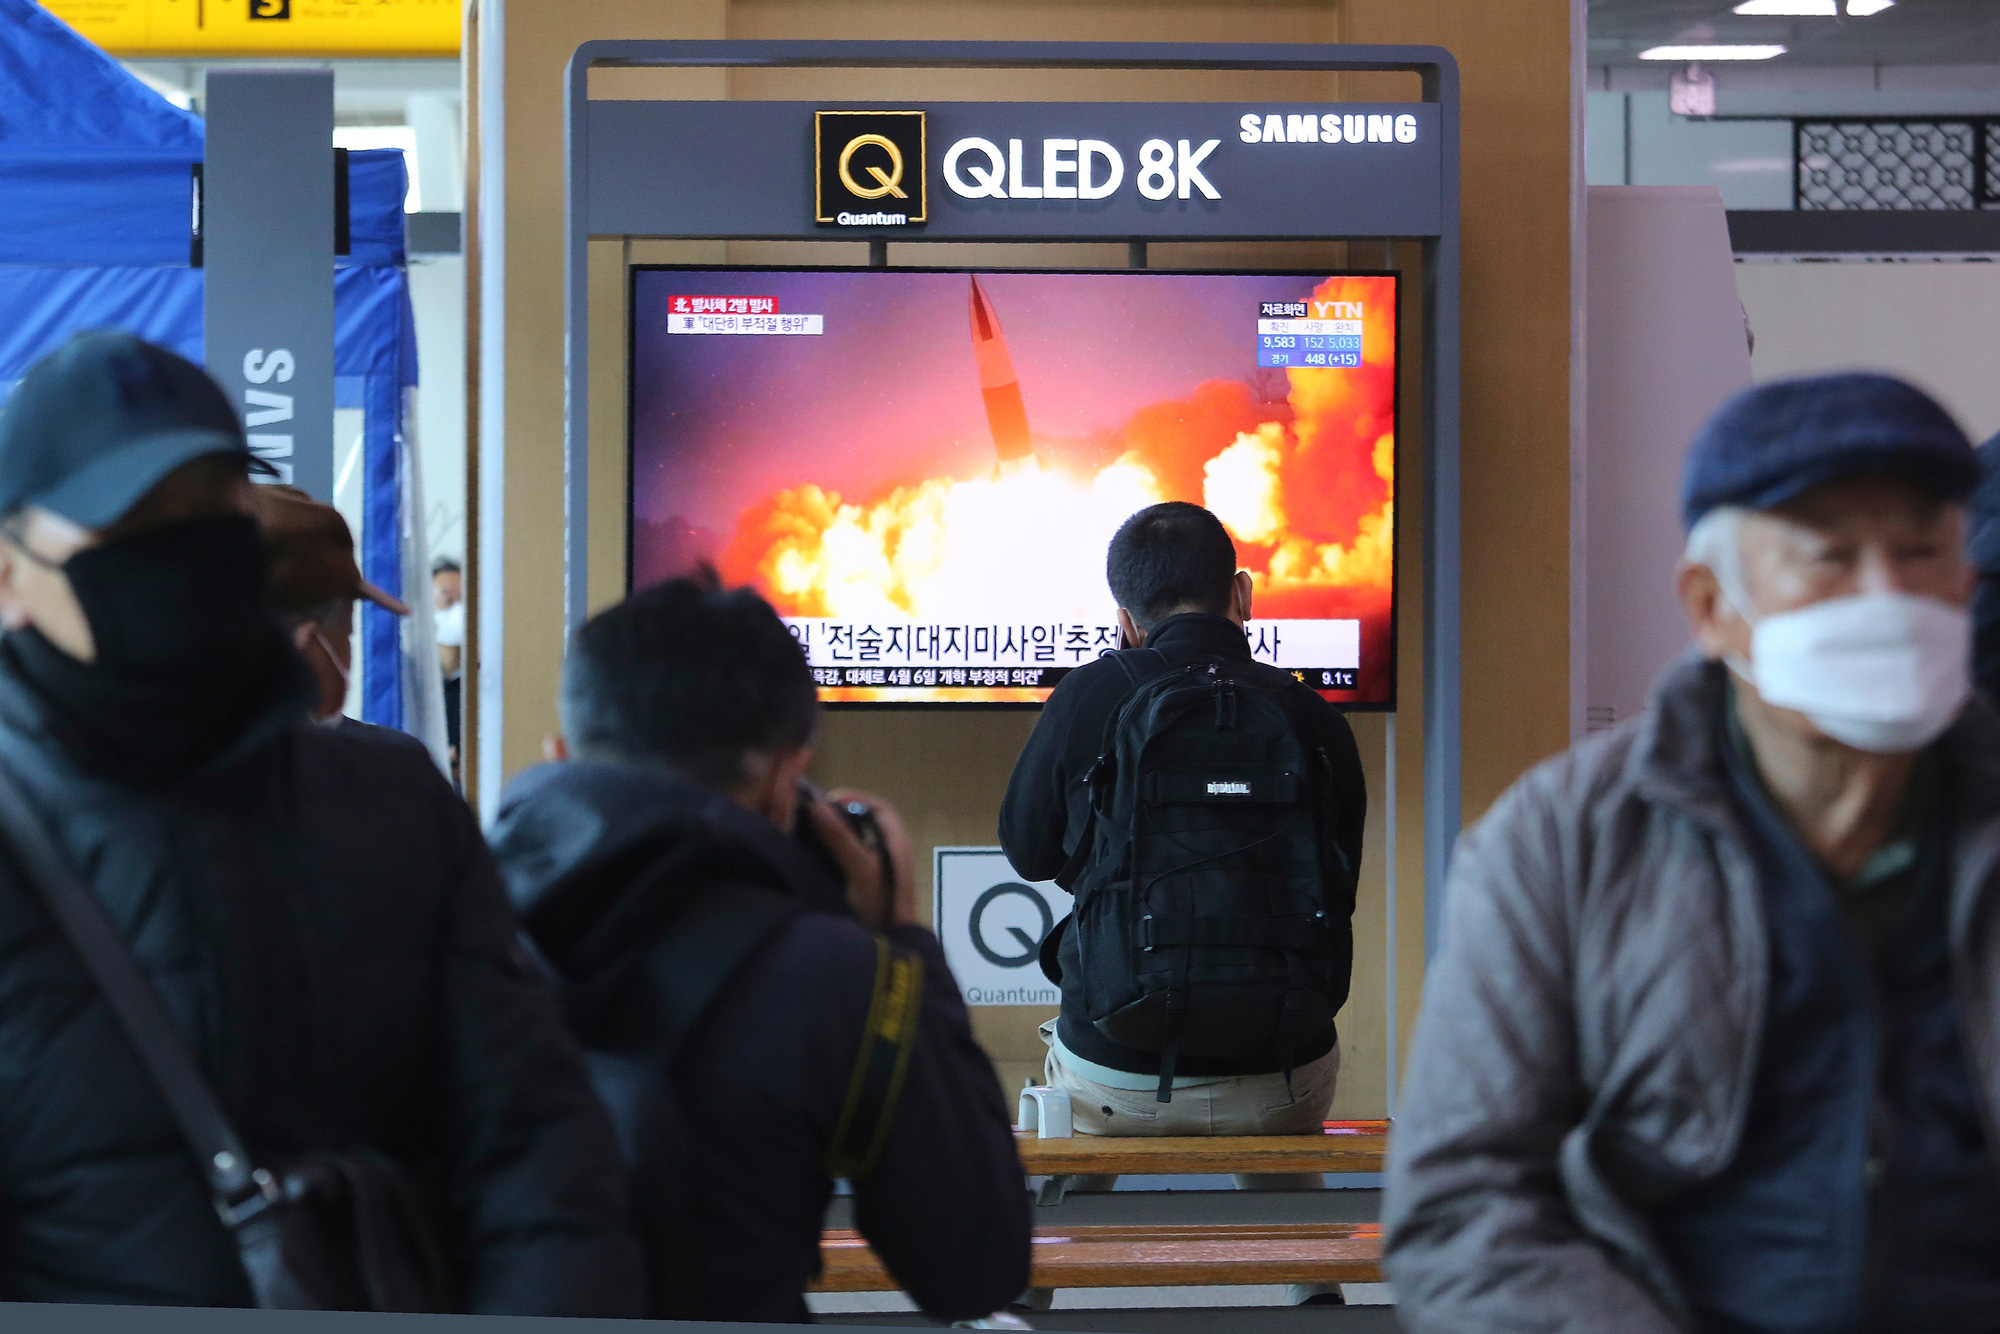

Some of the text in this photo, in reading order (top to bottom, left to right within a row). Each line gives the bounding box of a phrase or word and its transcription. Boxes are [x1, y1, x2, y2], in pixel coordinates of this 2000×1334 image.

[1239, 113, 1417, 144] SAMSUNG
[838, 133, 909, 199] Q
[943, 136, 1222, 200] QLED 8K
[836, 211, 907, 227] Quantum
[692, 298, 727, 313] 발사체
[728, 299, 748, 313] 2발
[750, 299, 773, 313] 발사
[1261, 303, 1305, 317] 자료화면
[1313, 301, 1362, 318] YTN
[683, 316, 809, 332] 軍 "대단히 부적절 행위"
[1304, 322, 1324, 334] 사망
[1334, 322, 1354, 333] 완치
[1304, 337, 1324, 349] 152
[1271, 354, 1357, 366] 경기 448 (+15)
[845, 668, 887, 685] 대체로
[888, 669, 911, 685] 4월
[913, 669, 937, 685] 6일
[938, 669, 967, 686] 개학
[968, 669, 1010, 686] 부정적
[1011, 669, 1044, 686] 의견"
[968, 882, 1054, 969] Q
[967, 986, 1056, 1003] Quantum
